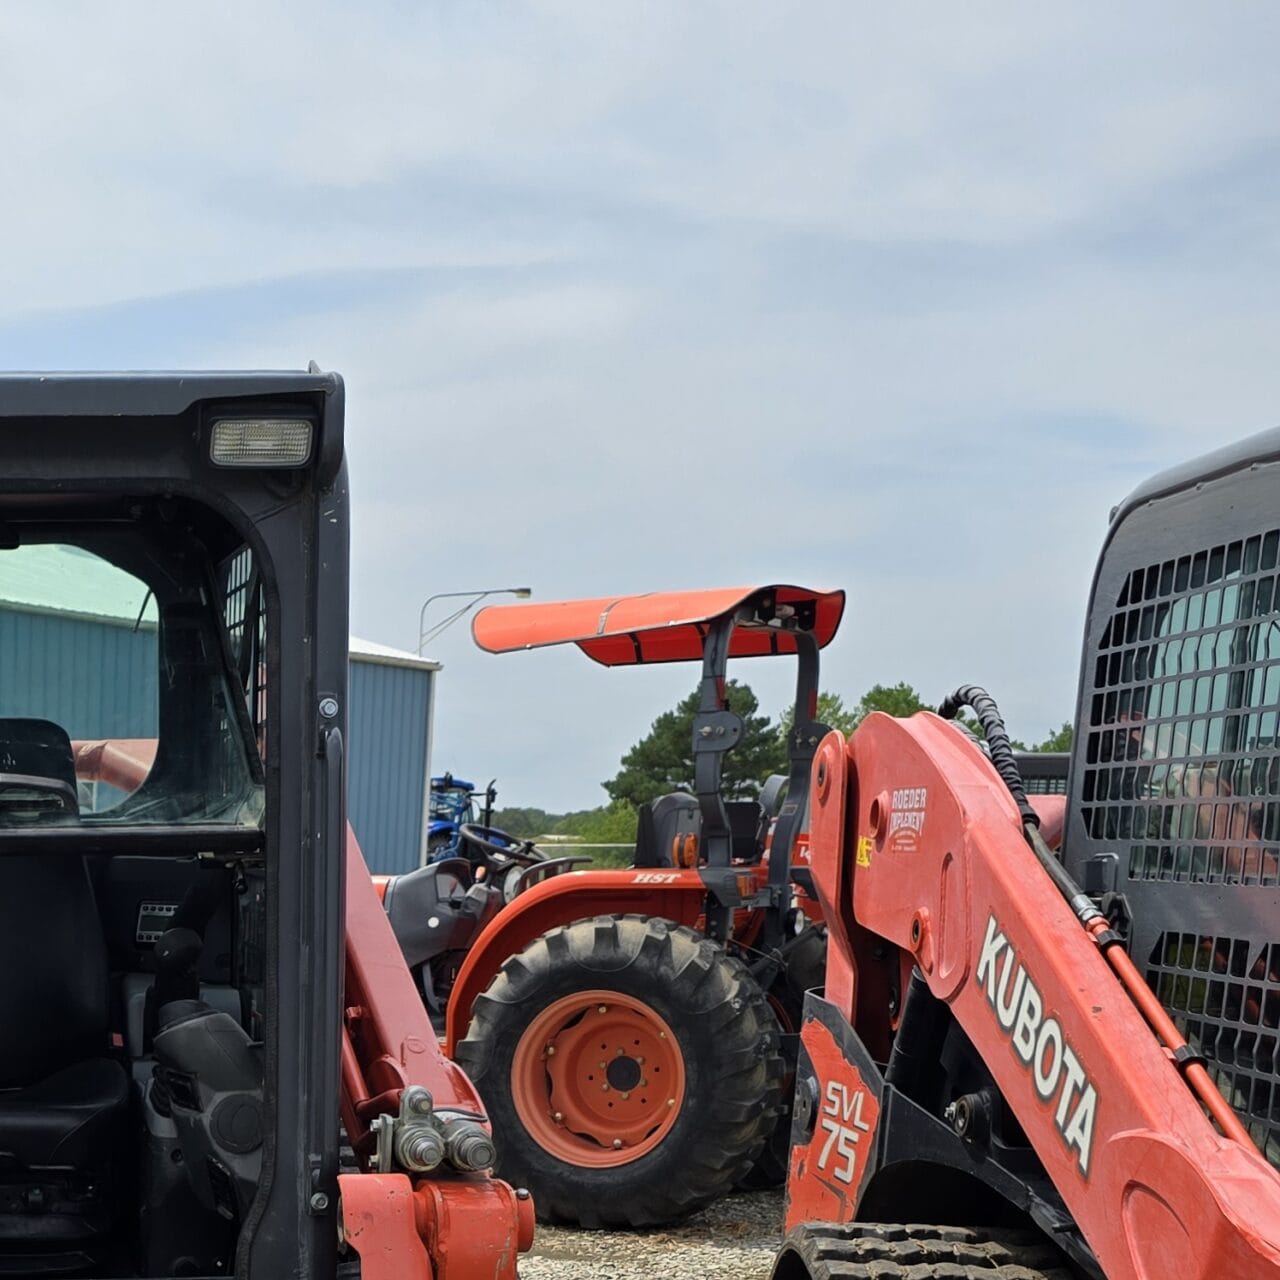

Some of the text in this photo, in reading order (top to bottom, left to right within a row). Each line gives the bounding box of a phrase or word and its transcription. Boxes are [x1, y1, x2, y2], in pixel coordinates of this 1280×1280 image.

[892, 788, 927, 809] ROEDER
[631, 873, 682, 884] HST
[976, 914, 1097, 1174] KUBOTA
[823, 1080, 870, 1131] SVL
[818, 1118, 859, 1184] 75
